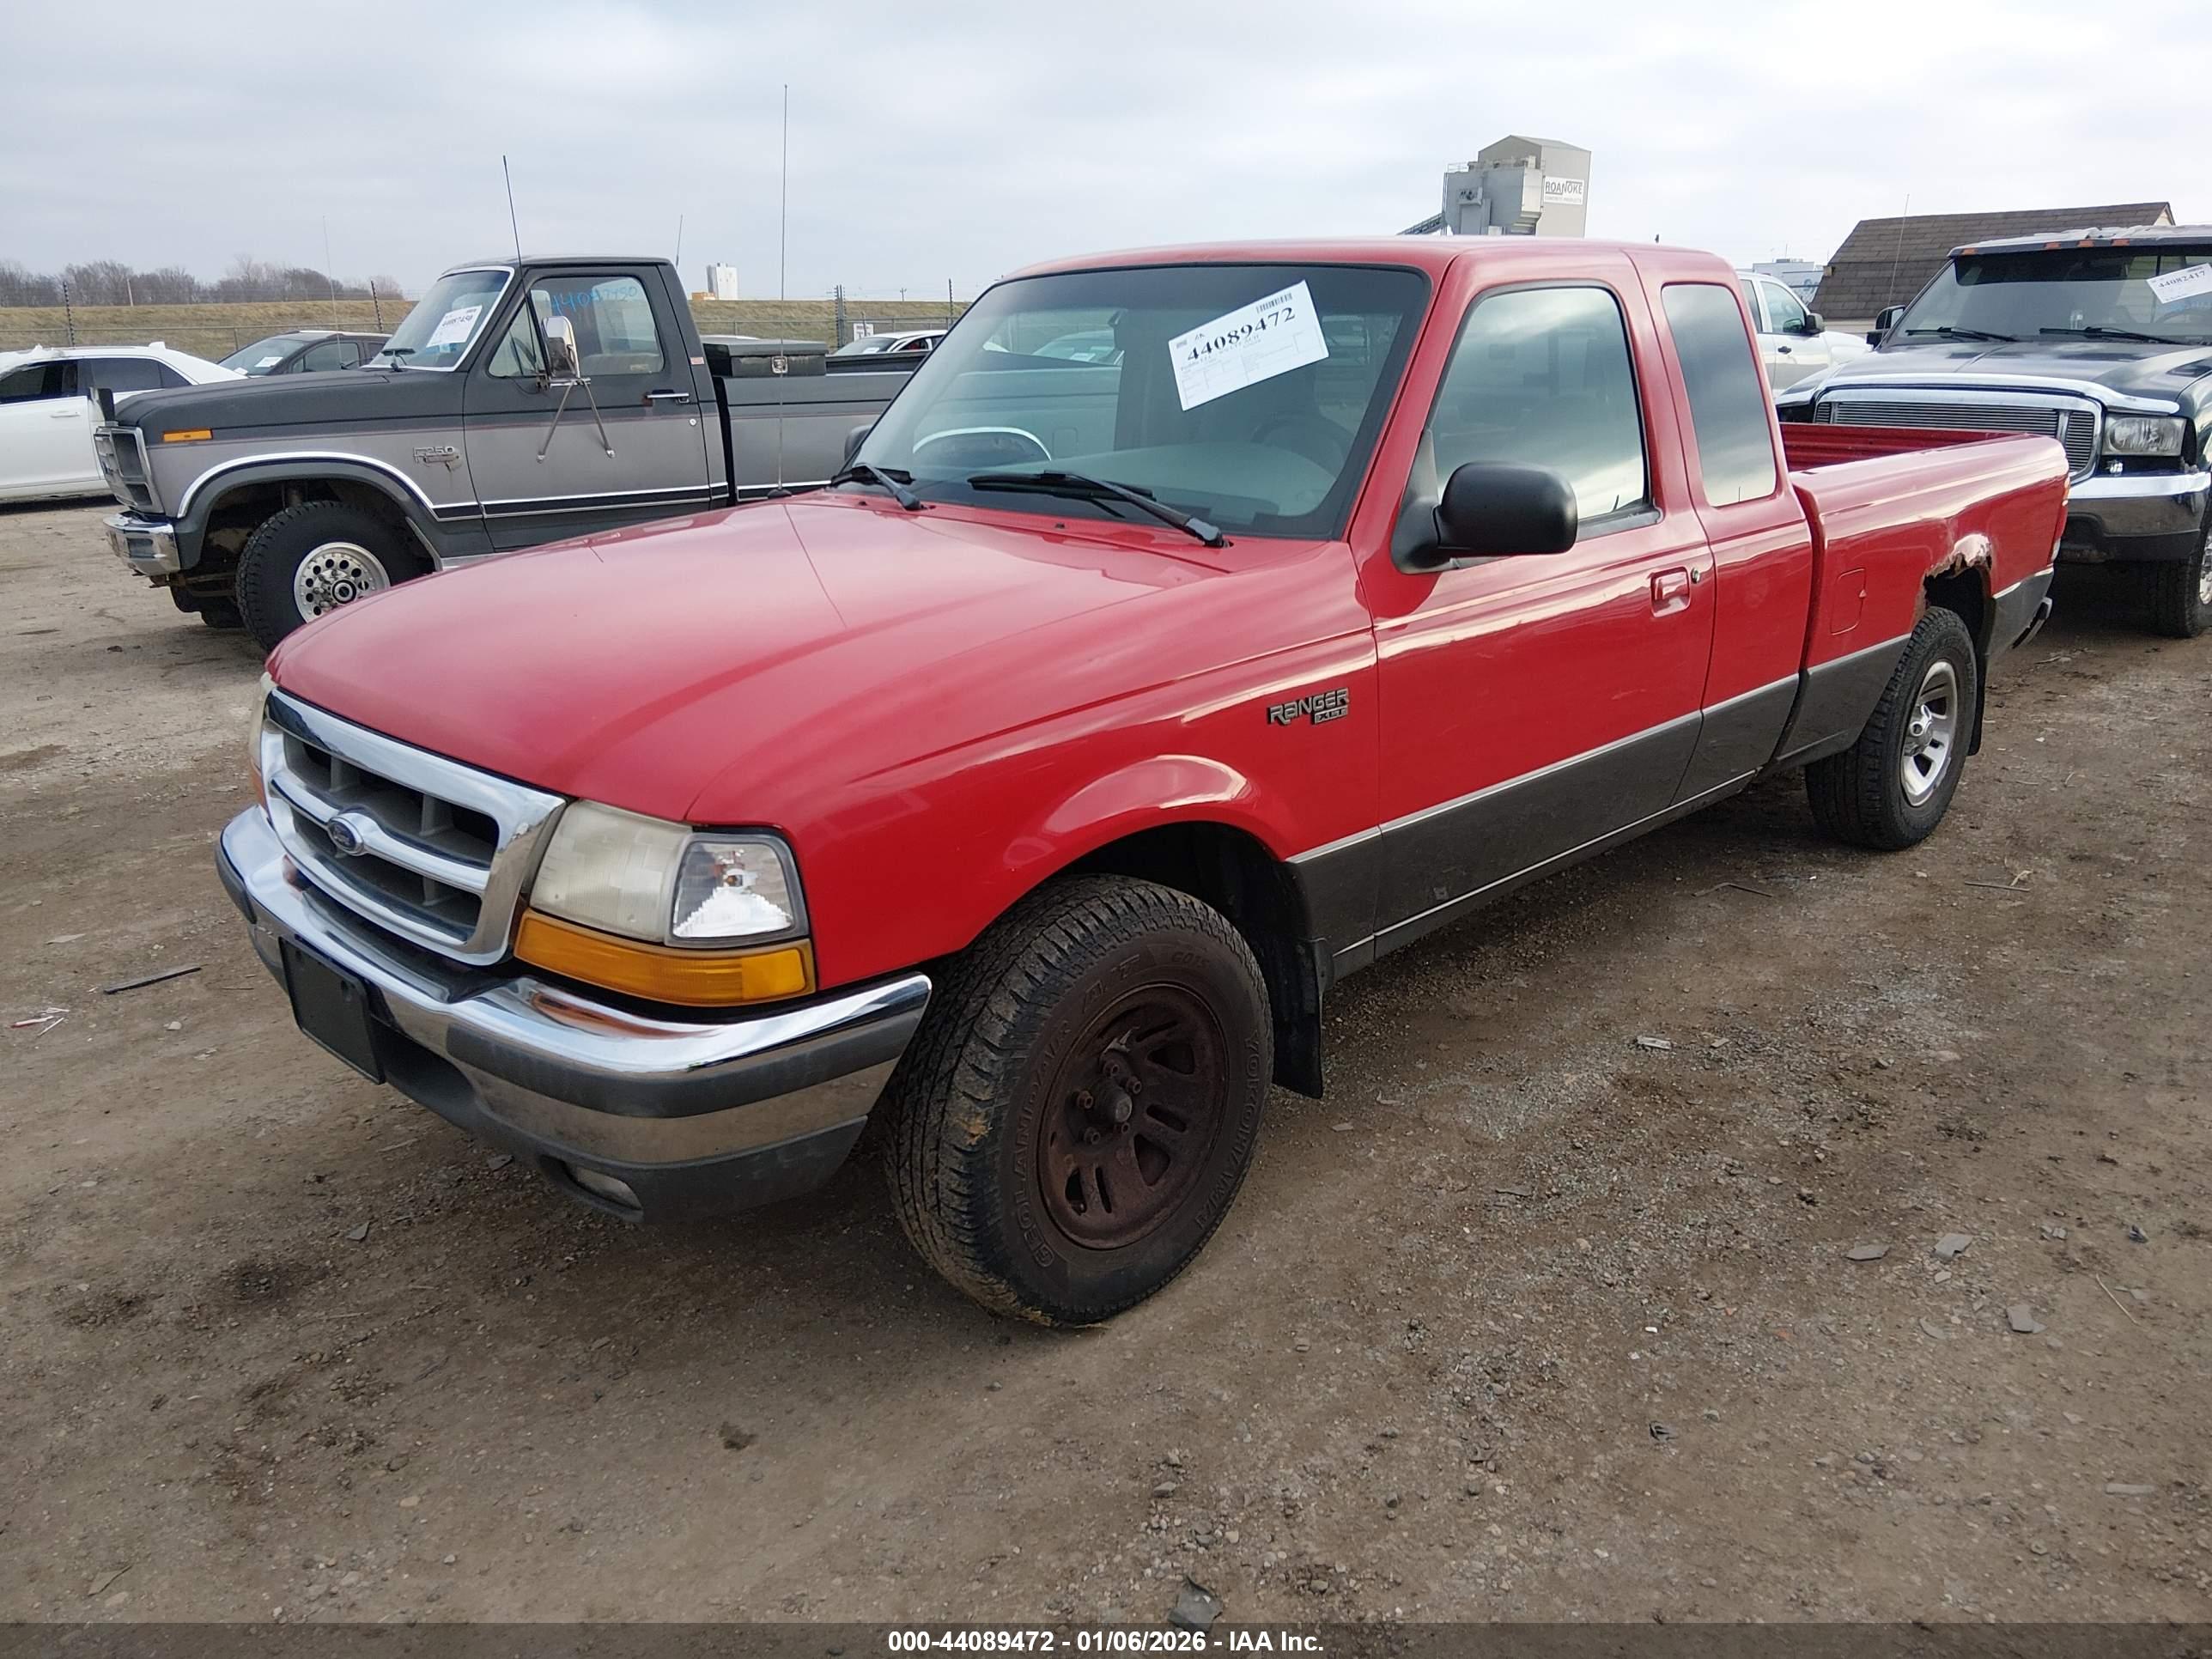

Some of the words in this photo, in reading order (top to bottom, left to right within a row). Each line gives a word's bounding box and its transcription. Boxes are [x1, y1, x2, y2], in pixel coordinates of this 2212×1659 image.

[1546, 181, 1583, 194] ROANOKE
[1188, 307, 1296, 361] 44089472
[1268, 687, 1350, 726] RANGER
